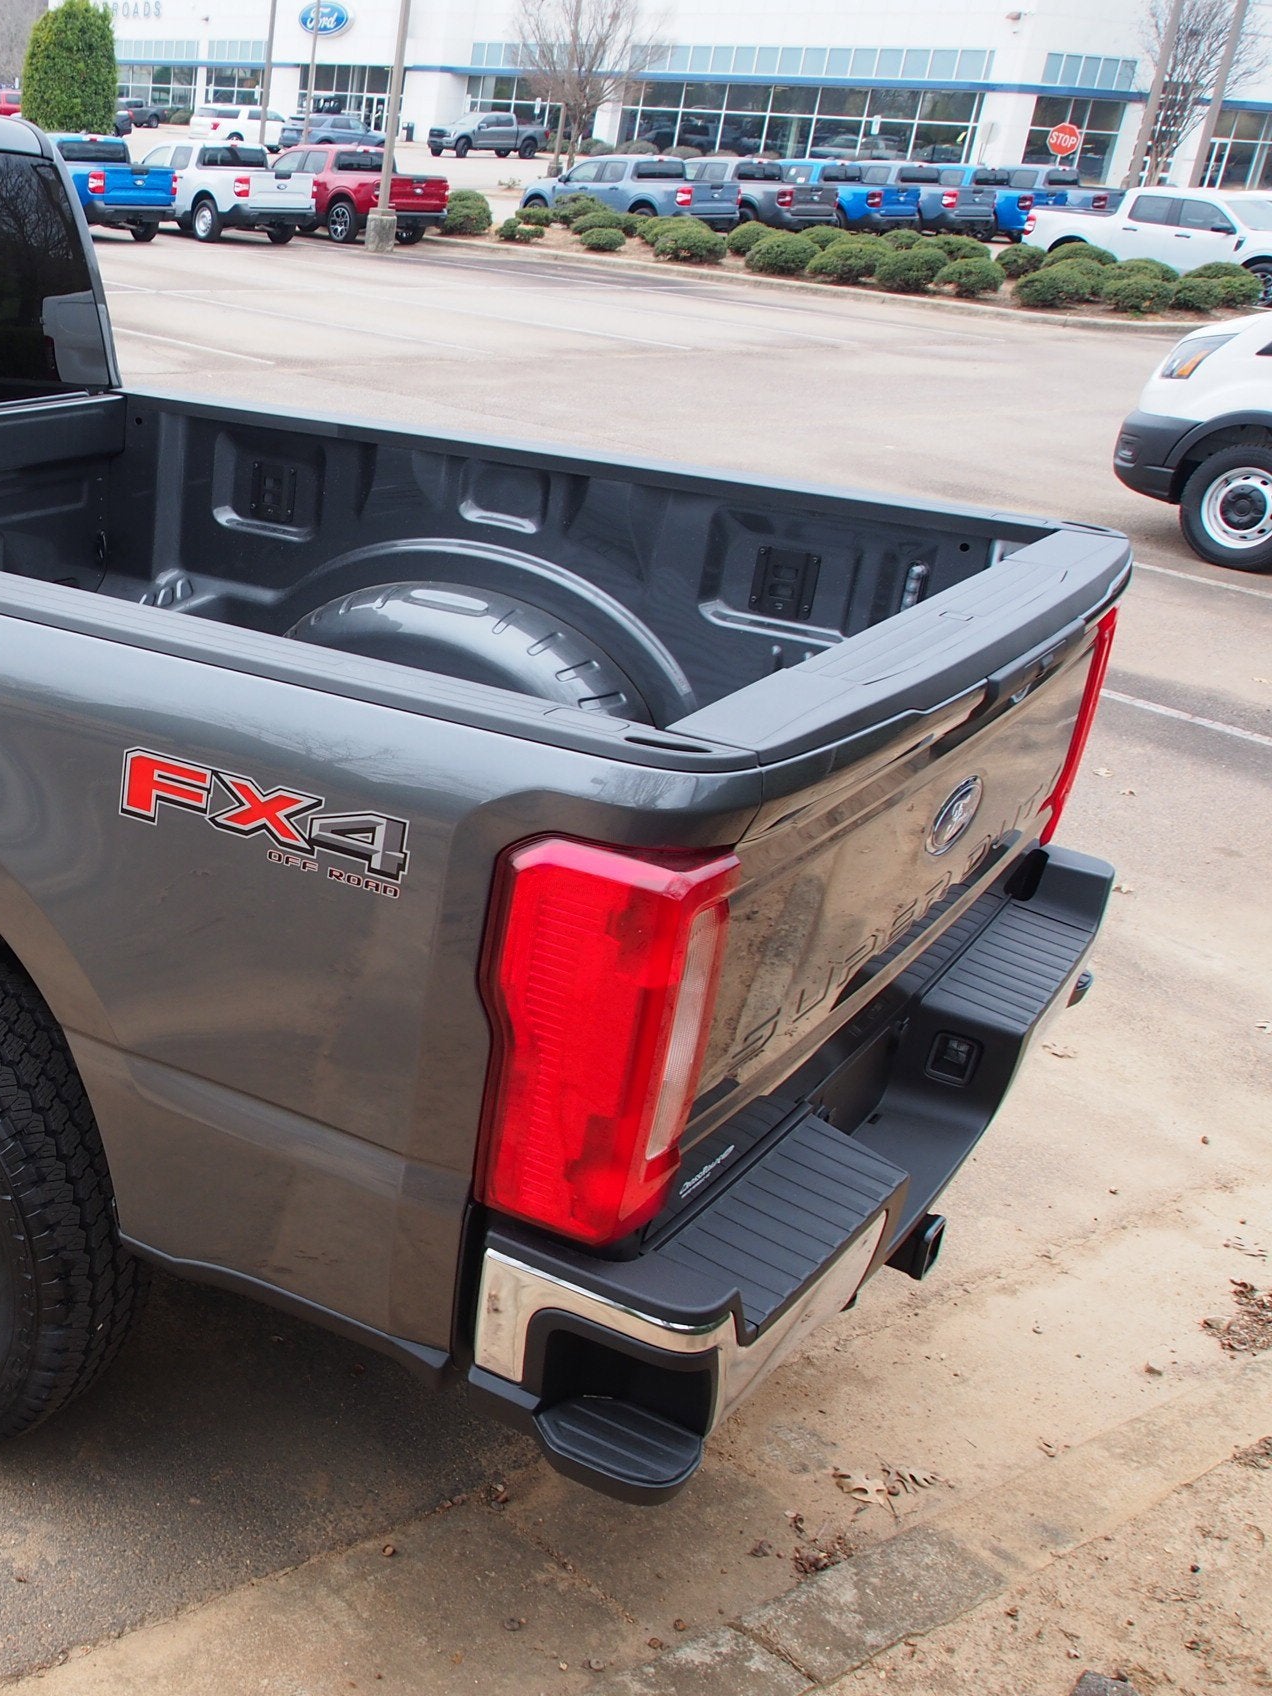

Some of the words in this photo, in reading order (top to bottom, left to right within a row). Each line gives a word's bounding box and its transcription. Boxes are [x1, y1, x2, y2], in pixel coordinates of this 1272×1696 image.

[1049, 131, 1078, 149] STOP
[119, 746, 410, 883] FX4
[266, 849, 319, 873] OFF
[327, 868, 401, 899] ROAD
[728, 870, 953, 1074] SUPER
